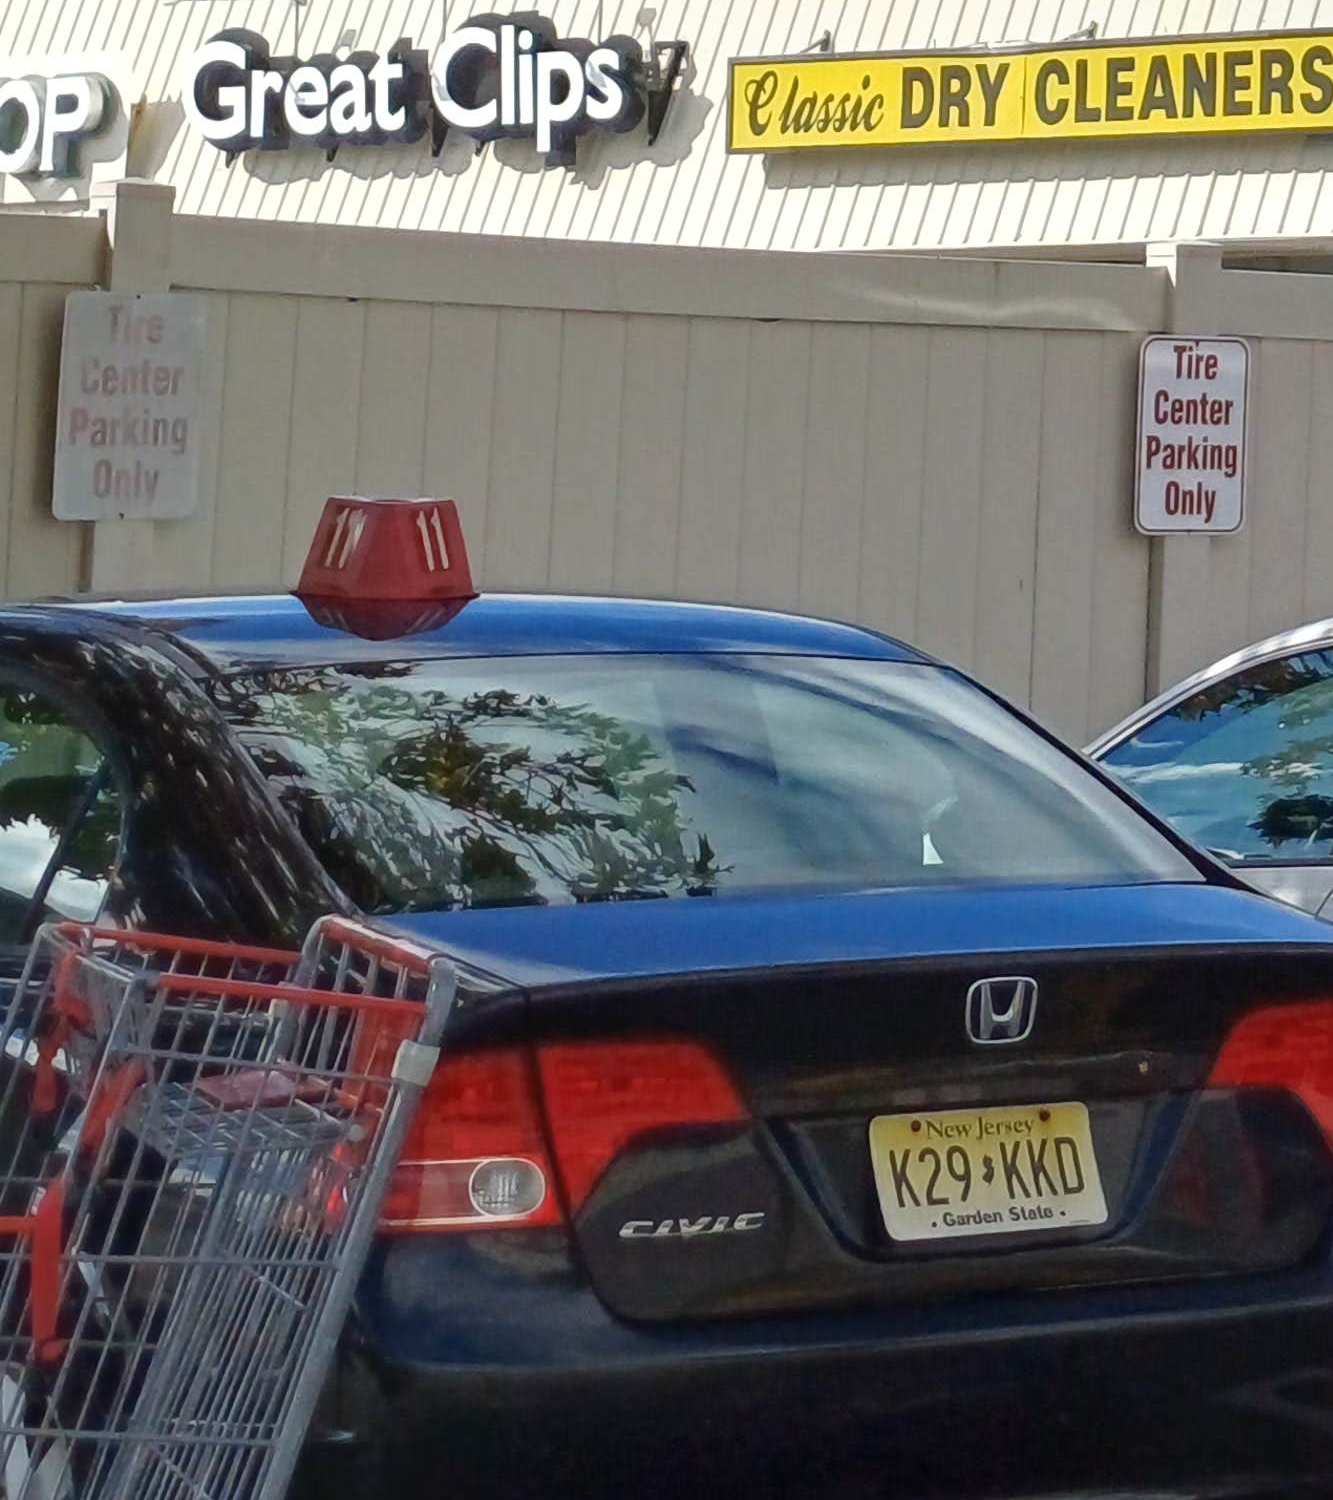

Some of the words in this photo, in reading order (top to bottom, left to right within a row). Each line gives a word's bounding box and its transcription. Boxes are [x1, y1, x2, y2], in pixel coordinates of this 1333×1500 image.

[187, 40, 406, 140] Great
[431, 24, 623, 153] Clips
[744, 70, 885, 137] Classic
[900, 62, 1011, 129] DRY
[107, 304, 166, 345] Tire
[80, 355, 186, 396] Center
[1174, 344, 1219, 380] Tire
[1154, 390, 1234, 425] Center
[68, 406, 190, 455] Parking
[1146, 435, 1238, 478] Parking
[92, 458, 161, 507] Only
[1164, 480, 1216, 524] Only
[416, 507, 450, 573] 11
[926, 1120, 972, 1139] New
[976, 1116, 1036, 1140] Jersey
[619, 1212, 766, 1238] CIVIC
[942, 1210, 1003, 1228] Garden
[1008, 1205, 1054, 1222] State
